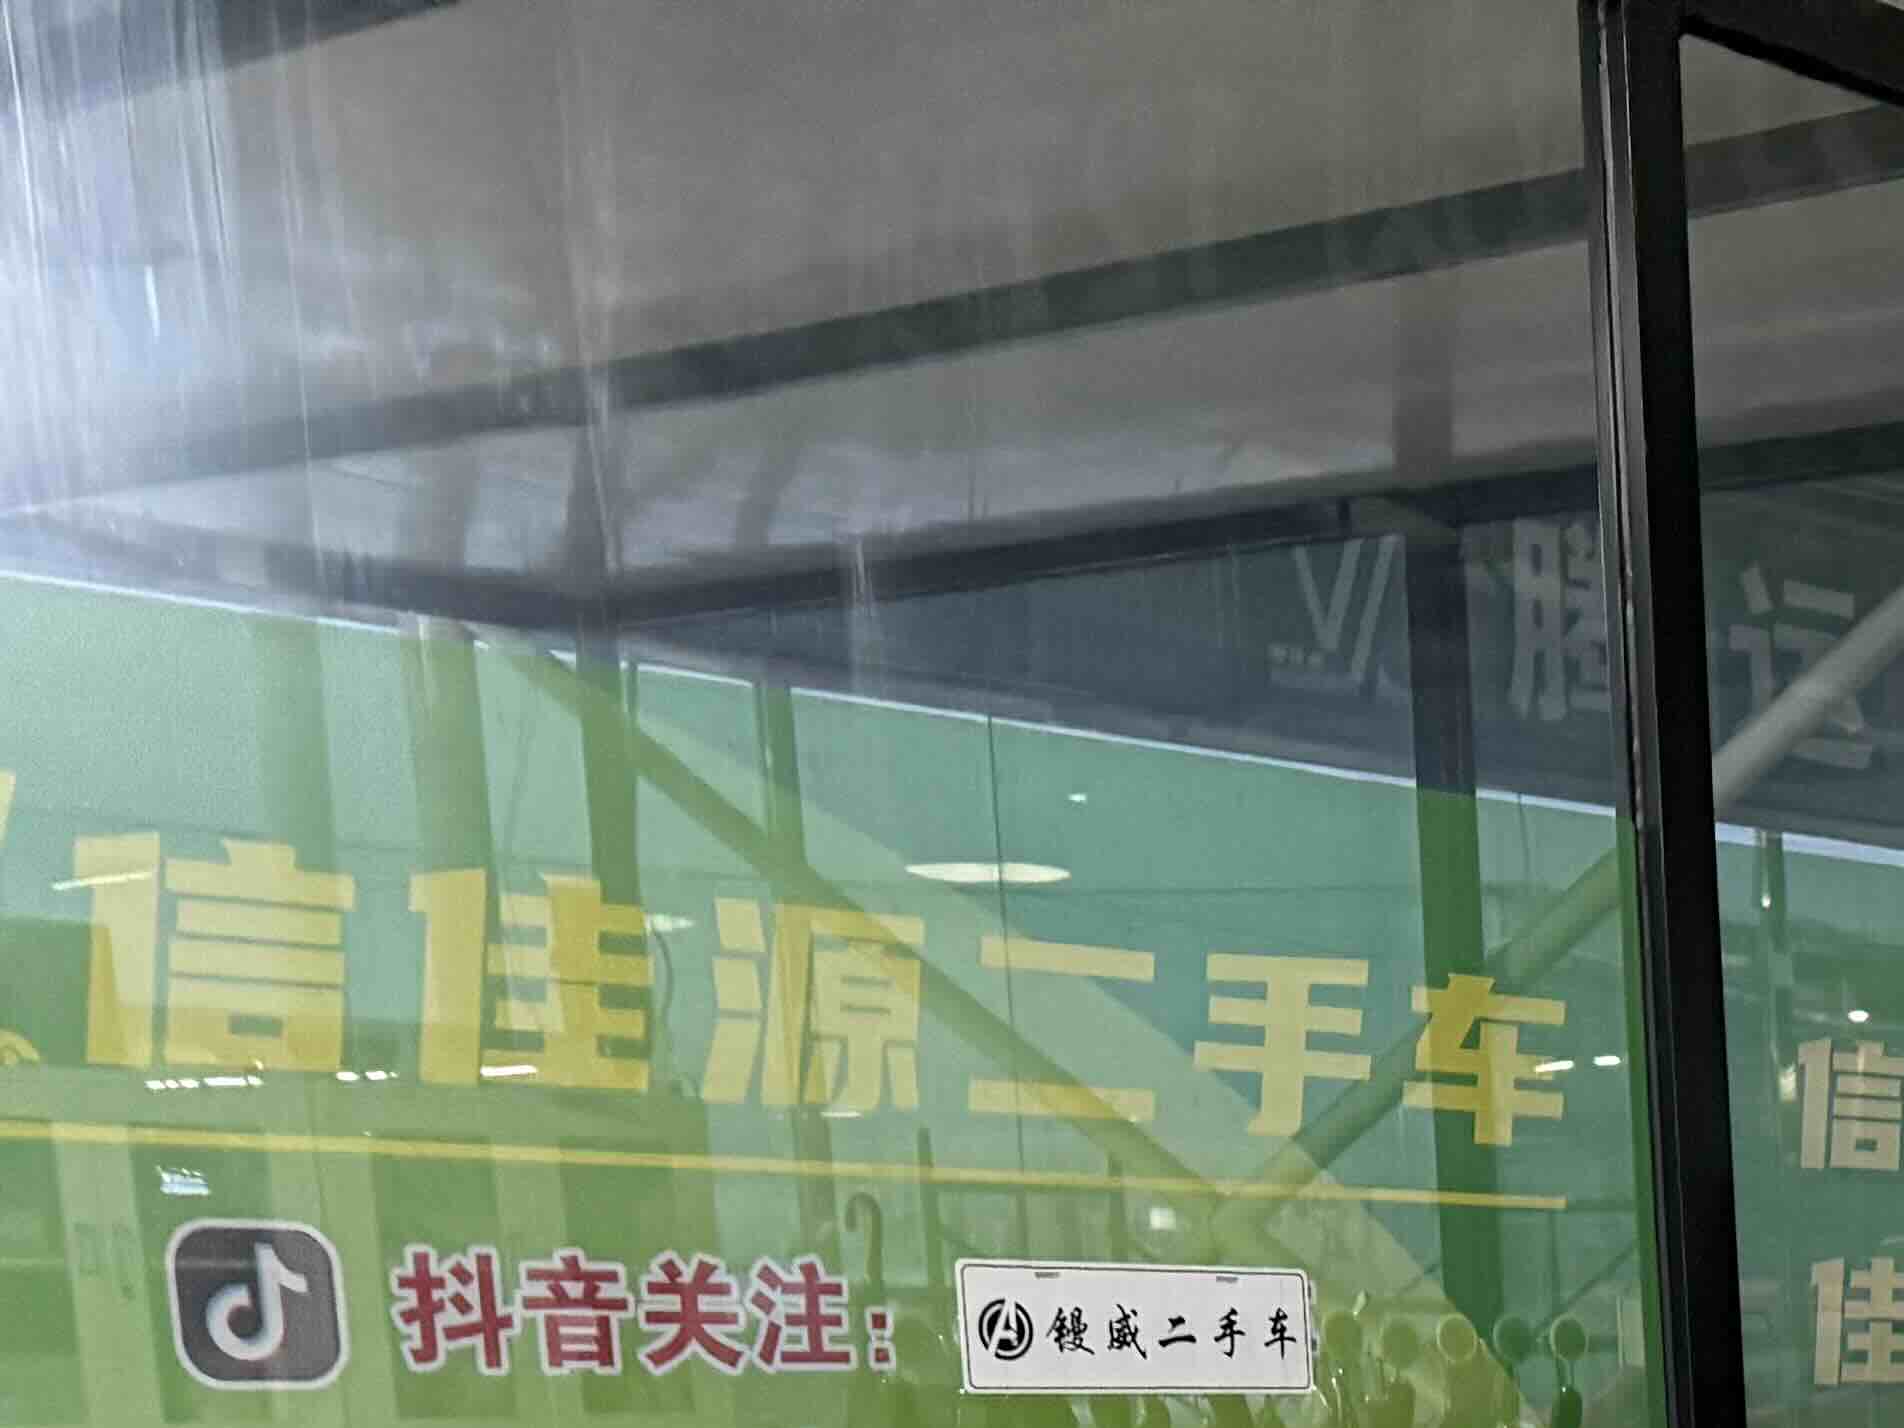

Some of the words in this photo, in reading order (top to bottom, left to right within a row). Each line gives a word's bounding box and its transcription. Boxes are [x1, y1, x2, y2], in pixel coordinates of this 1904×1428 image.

[75, 830, 1567, 1147] 信佳源二手车
